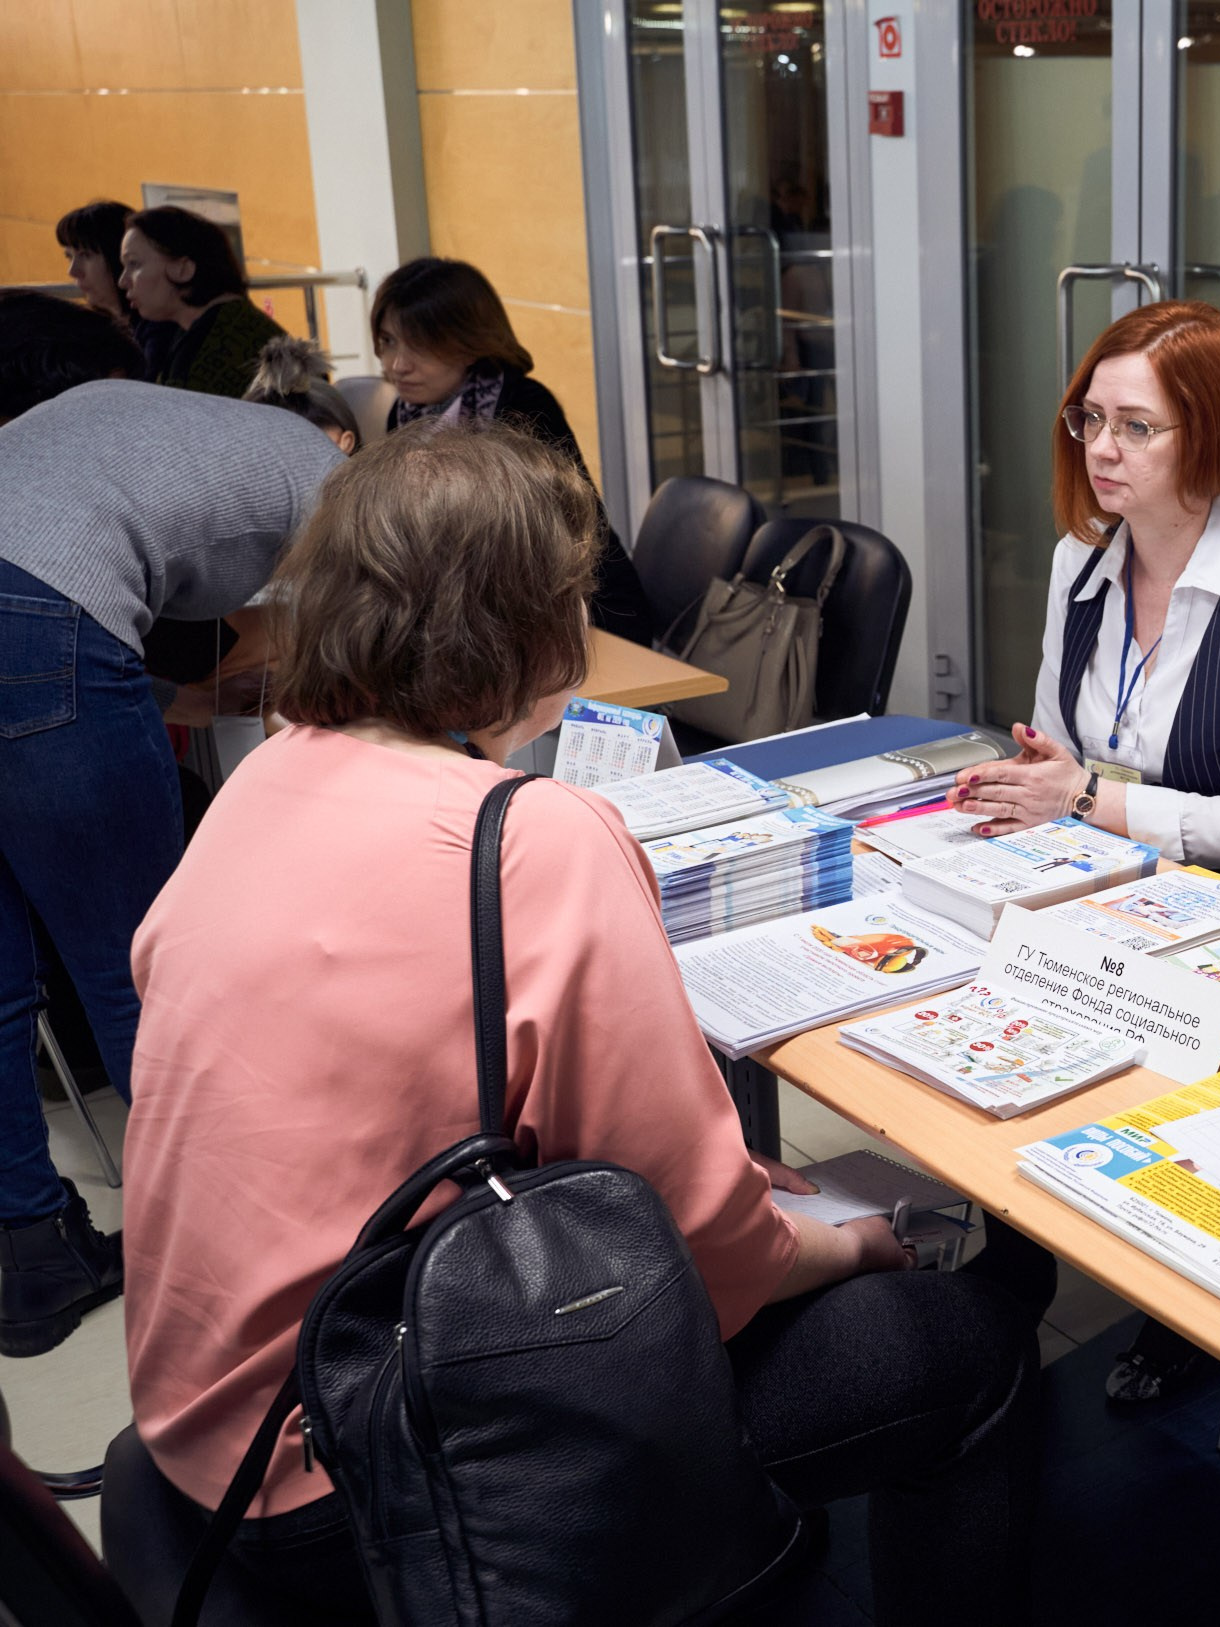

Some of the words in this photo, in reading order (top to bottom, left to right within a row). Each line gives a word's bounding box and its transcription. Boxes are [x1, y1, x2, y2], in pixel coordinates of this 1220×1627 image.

[978, 0, 1097, 20] ОСТОРОЖНО
[1017, 944, 1036, 960] ГУ
[1038, 951, 1105, 990] Тюменское
[1106, 982, 1201, 1029] региональное
[1100, 955, 1125, 977] №8
[1004, 962, 1069, 997] отделение
[1072, 987, 1113, 1016] Фонда
[1115, 1007, 1201, 1051] социального
